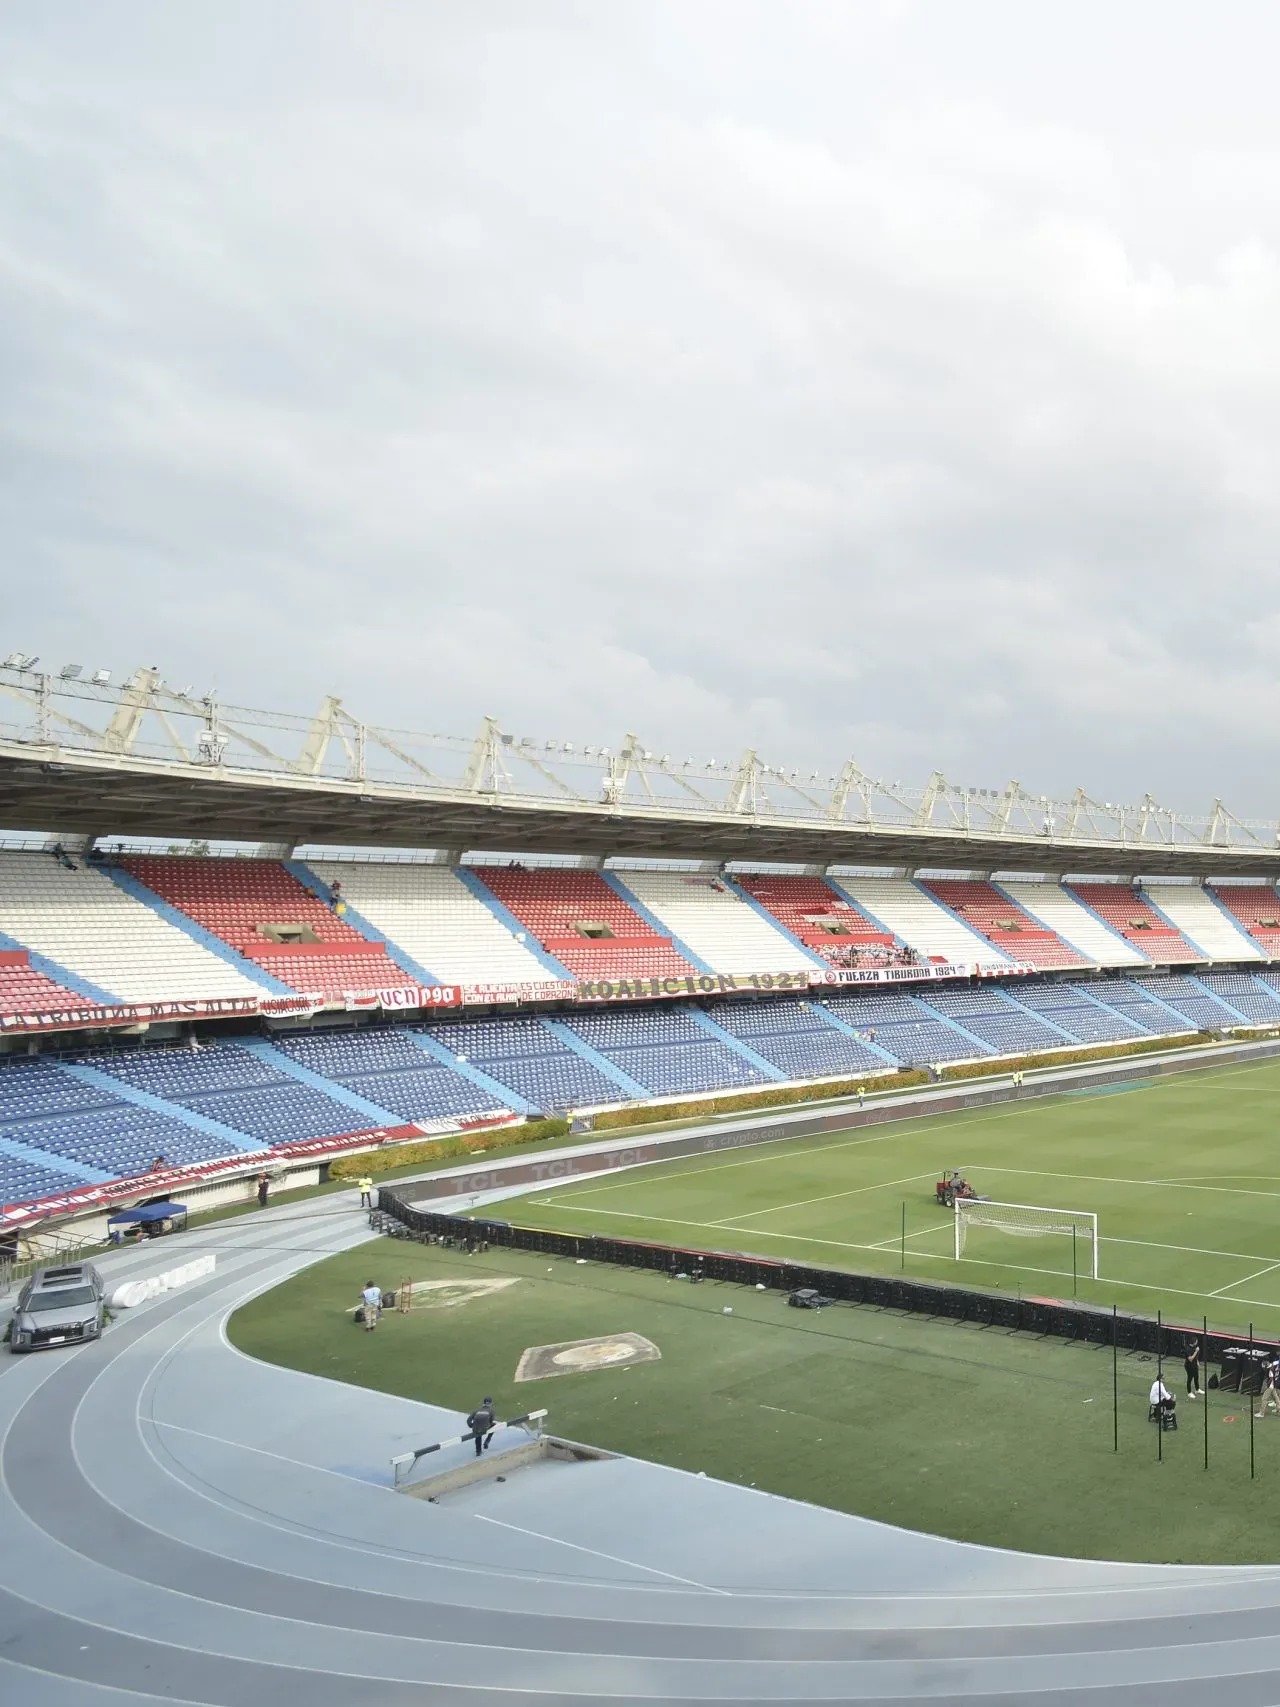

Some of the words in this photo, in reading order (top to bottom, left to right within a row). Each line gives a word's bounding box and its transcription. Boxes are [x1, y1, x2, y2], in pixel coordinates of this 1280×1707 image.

[839, 970, 880, 982] FUERZA
[935, 966, 957, 977] 1924
[579, 974, 738, 1000] KOALICION
[748, 972, 807, 989] 1924
[31, 1006, 138, 1029] TRIBUNA
[205, 999, 252, 1014] ALTA
[964, 1096, 983, 1108] bwin
[720, 1125, 785, 1147] crypto.com
[531, 1159, 581, 1181] TCL
[603, 1149, 648, 1169] TCL
[450, 1172, 505, 1195] TCL
